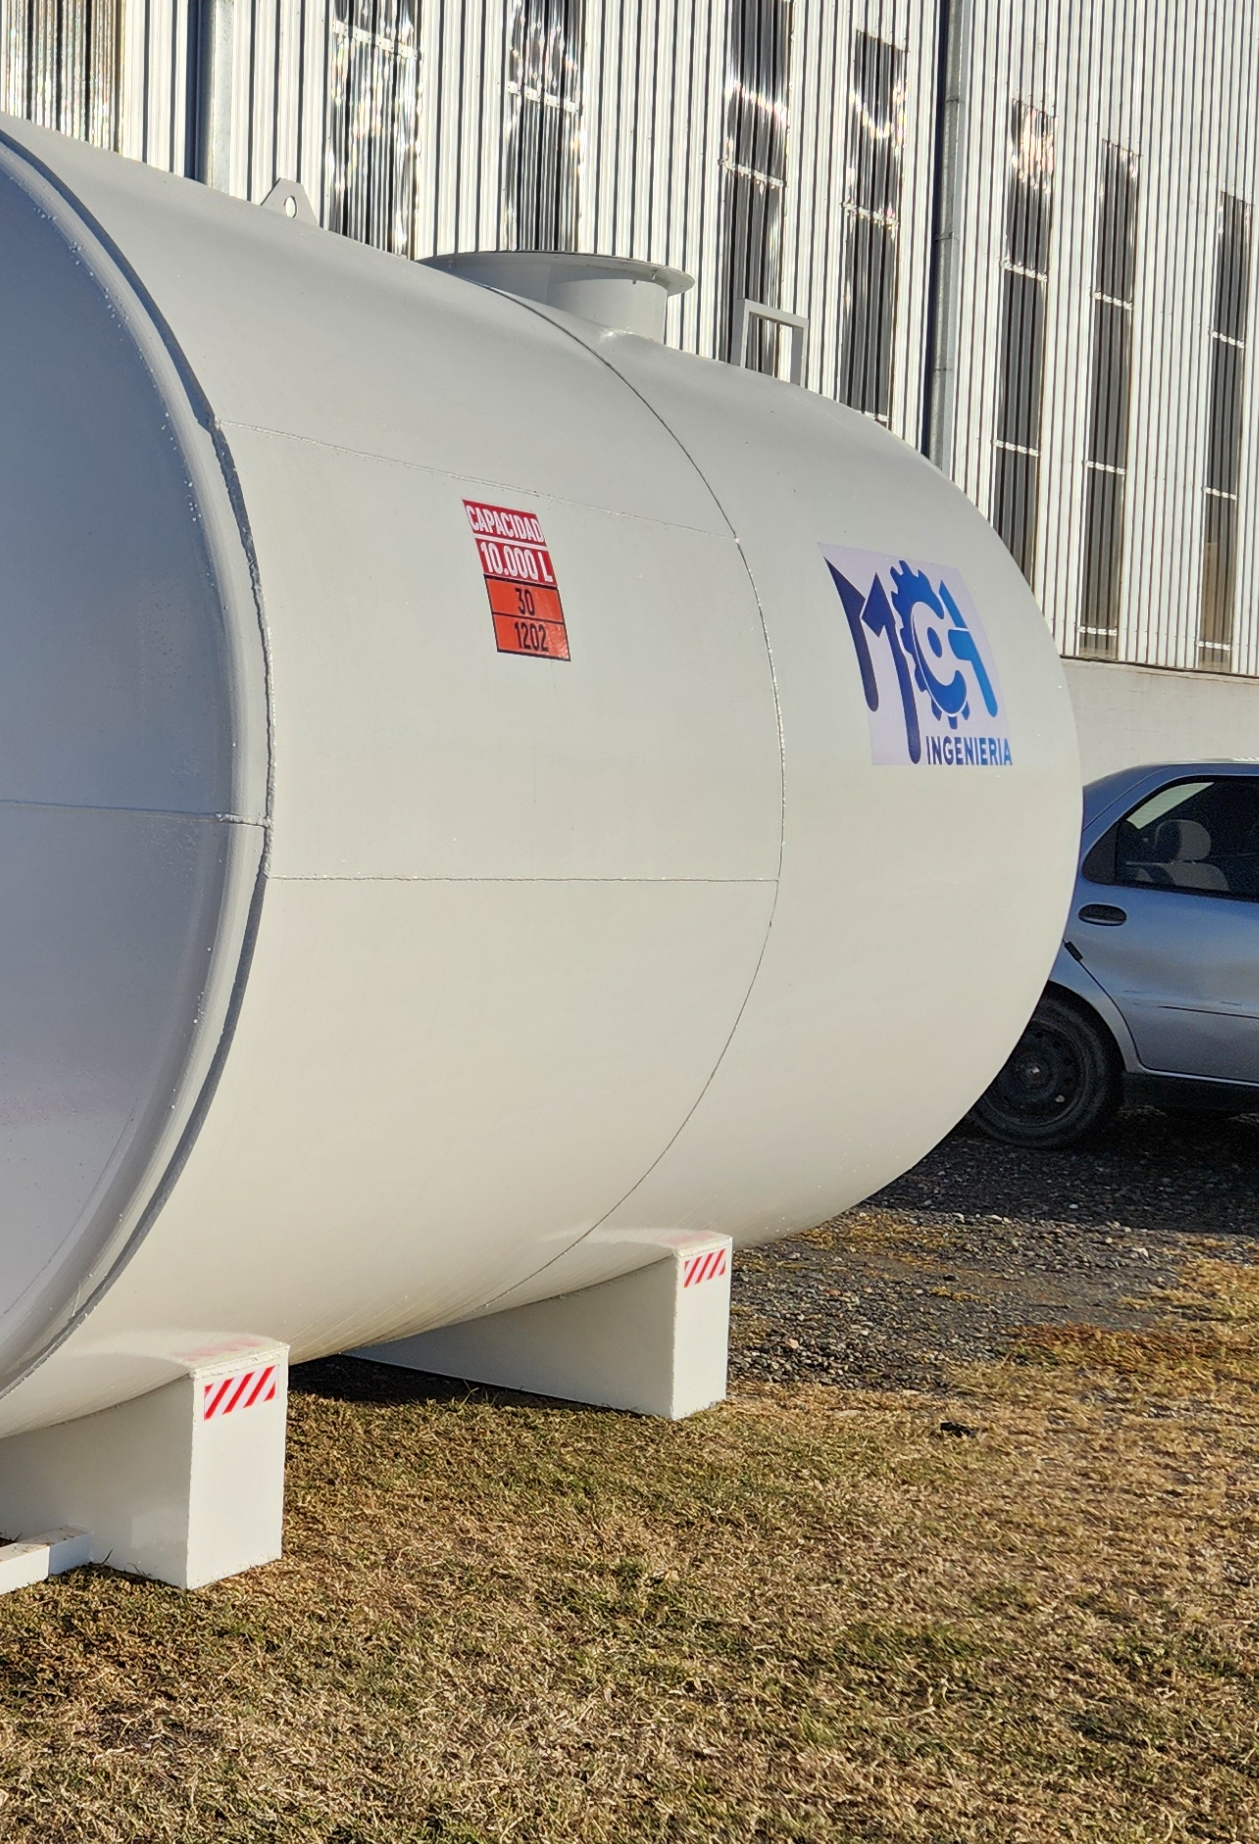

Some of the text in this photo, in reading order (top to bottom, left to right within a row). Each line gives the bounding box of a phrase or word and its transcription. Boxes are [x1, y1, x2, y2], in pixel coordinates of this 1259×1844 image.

[466, 505, 546, 543] CAPACIDAD
[480, 542, 553, 582] 10.000 L
[515, 588, 535, 616] 30
[515, 621, 549, 652] 1202
[823, 556, 998, 764] MCA
[925, 736, 1013, 766] INGENIERIA
